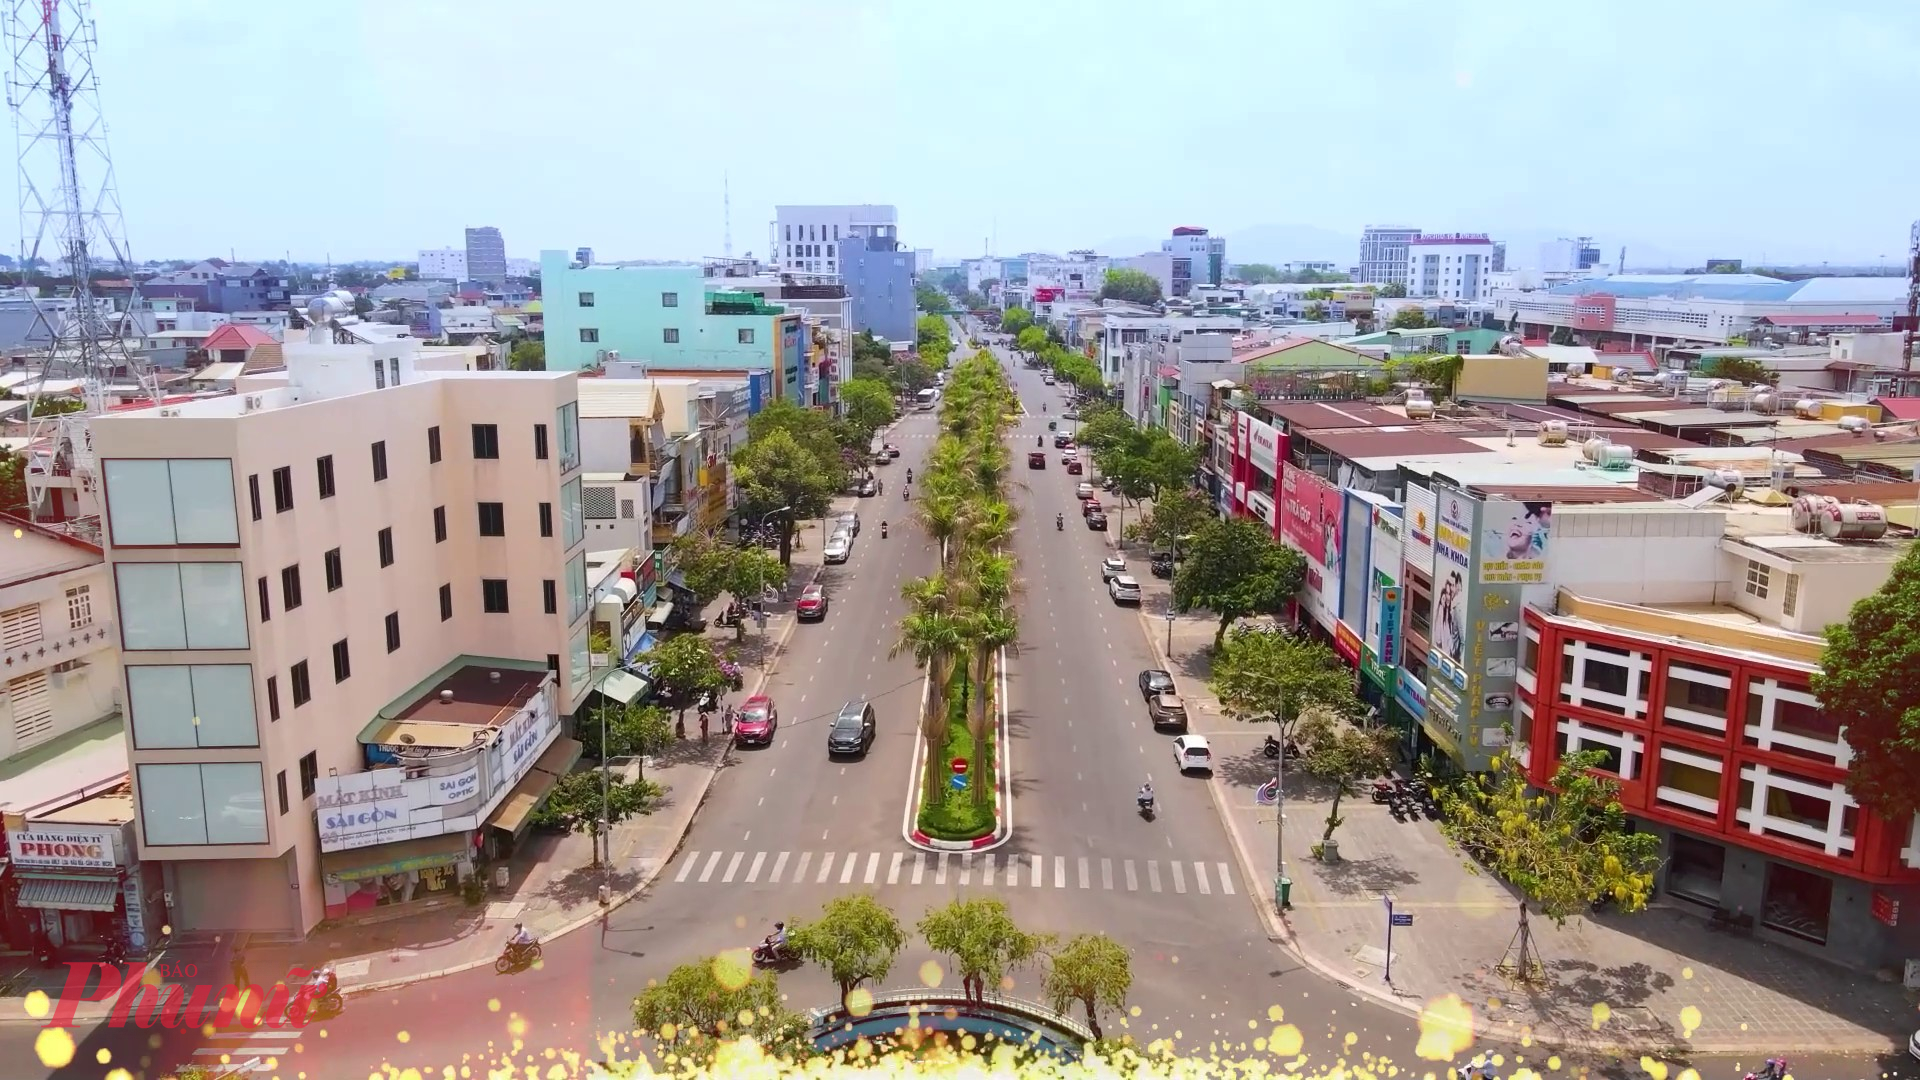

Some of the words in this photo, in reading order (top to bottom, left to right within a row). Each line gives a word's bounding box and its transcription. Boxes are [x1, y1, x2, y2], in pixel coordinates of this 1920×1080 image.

[1436, 541, 1449, 559] NHA
[1450, 549, 1469, 570] KHOA
[438, 780, 456, 791] SAI
[457, 774, 477, 786] GON
[447, 786, 475, 800] OPTIC
[36, 832, 64, 842] HÀNG
[20, 842, 103, 859] PHONG
